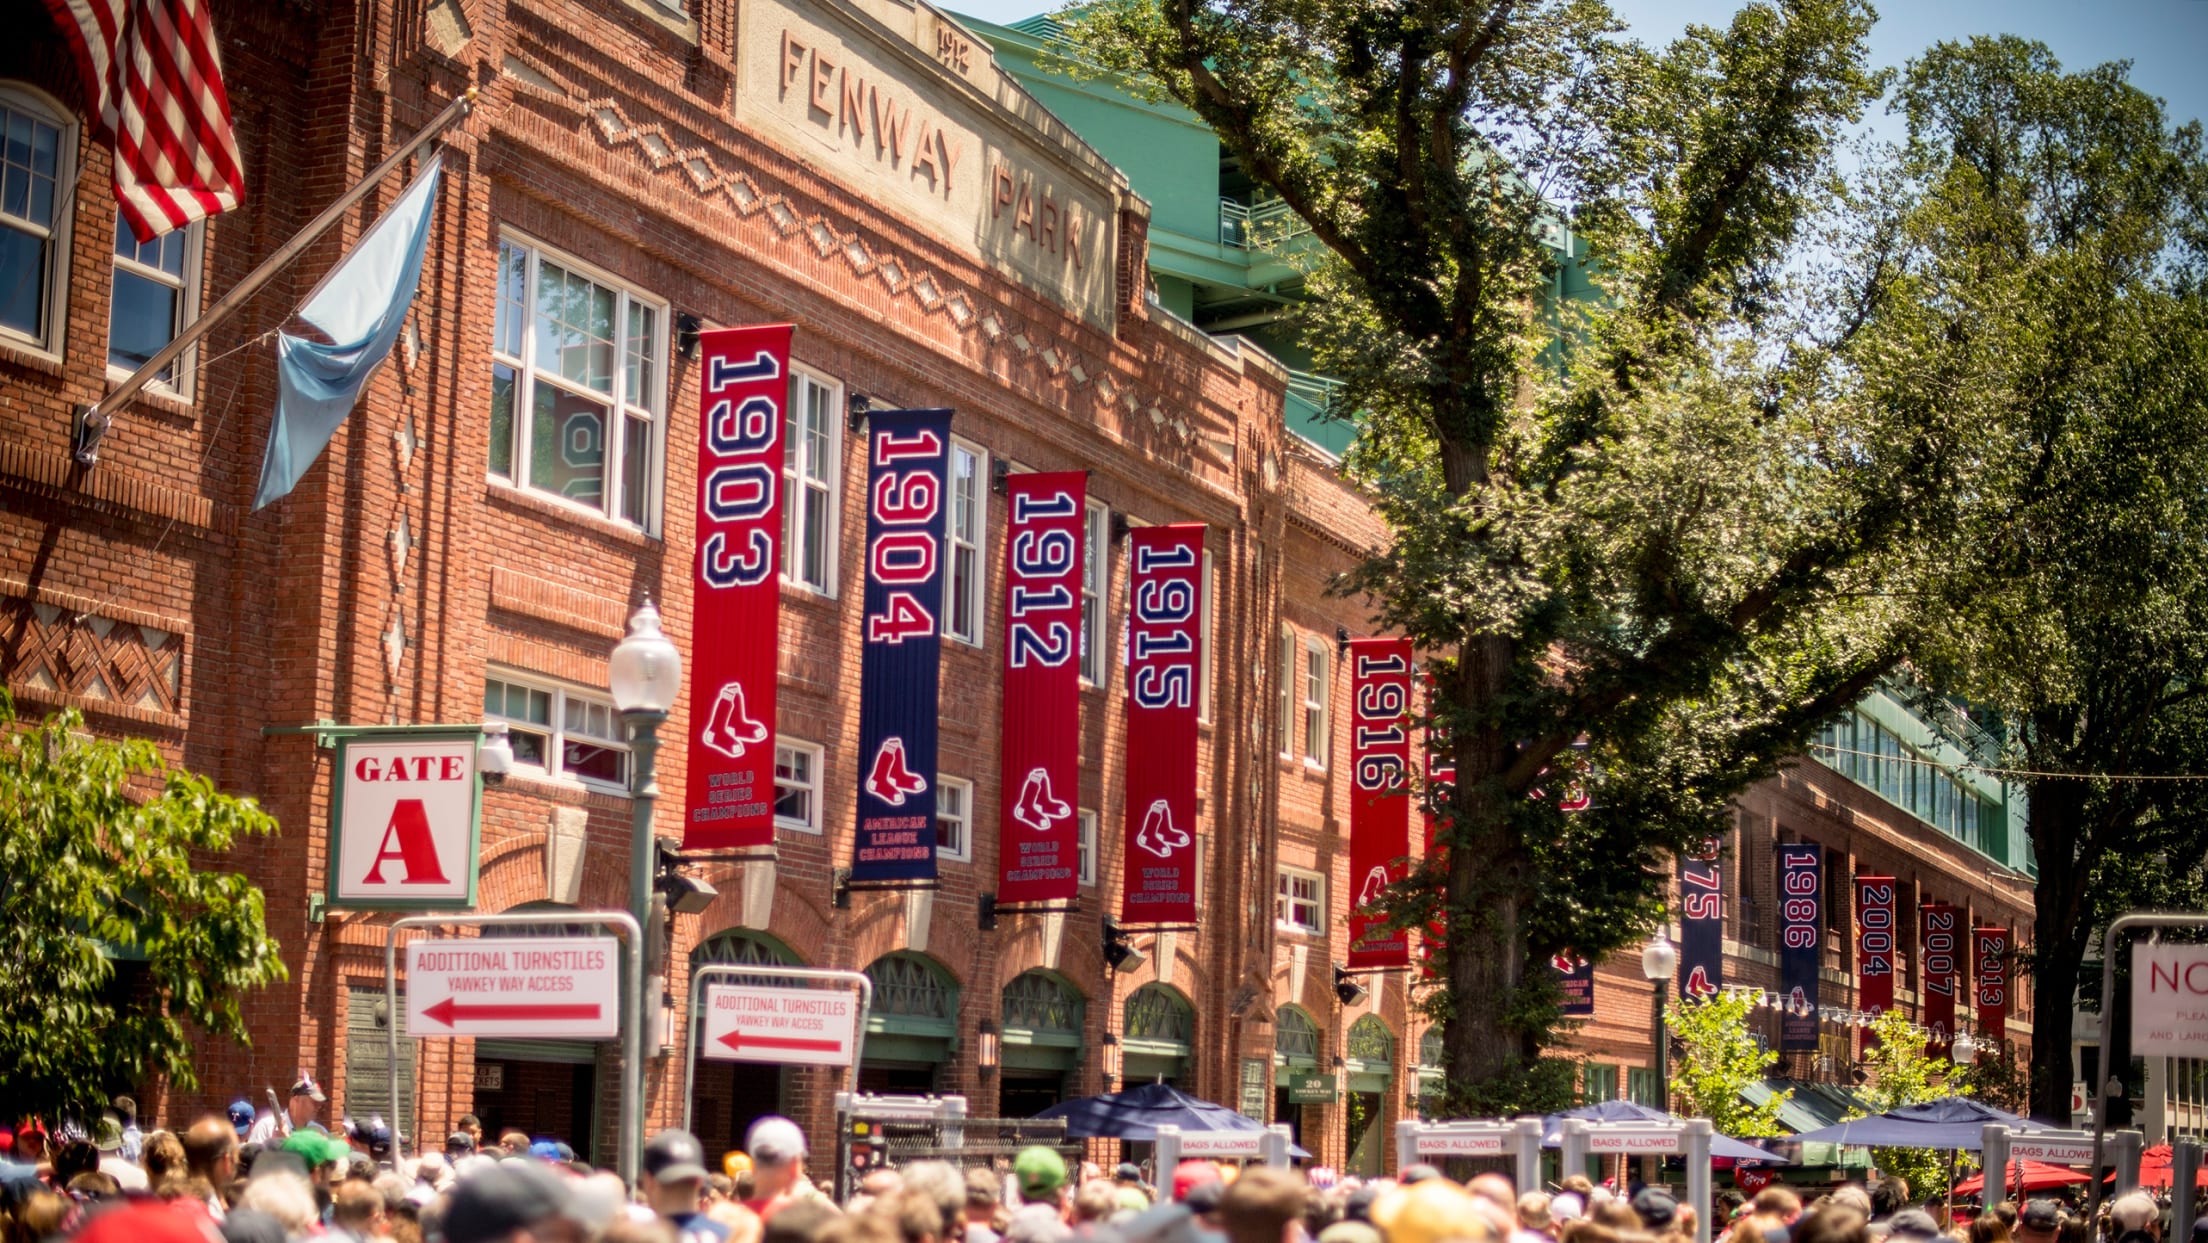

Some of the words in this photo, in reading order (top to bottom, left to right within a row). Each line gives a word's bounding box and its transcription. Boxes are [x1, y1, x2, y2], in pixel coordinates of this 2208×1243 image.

[937, 27, 969, 70] 1912
[782, 29, 961, 190] FENWAY
[993, 163, 1083, 269] PARK
[703, 351, 780, 588] 1903
[870, 430, 941, 643] 1904
[1011, 492, 1076, 668] 1912
[1135, 544, 1195, 708] 1915
[1357, 654, 1406, 790] 1916
[355, 755, 465, 782] GATE
[708, 770, 754, 787] WORLD
[708, 787, 752, 804] SERIES
[693, 802, 768, 822] CHAMPIONS
[863, 816, 927, 830] AMERICAN
[362, 799, 451, 884] A
[871, 831, 918, 845] LEAGUE
[859, 846, 930, 861] CHAMPIONS
[1684, 834, 1720, 919] 975
[1785, 853, 1816, 948] 1986
[1863, 885, 1891, 976] 2004
[417, 951, 508, 972] ADDITIONAL
[512, 950, 605, 970] TURNSTILES
[1927, 913, 1953, 996] 2007
[1981, 937, 2004, 1006] 2013
[447, 976, 496, 992] YAWKEY
[499, 976, 525, 992] WAY
[527, 975, 574, 992] ACCESS
[715, 995, 779, 1012] ADDITIONAL
[782, 998, 846, 1016] TURNSTILES
[736, 1014, 769, 1027] YAWKEY
[771, 1016, 789, 1028] WAY
[792, 1017, 824, 1031] ACCESS
[2150, 1031, 2174, 1041] AND
[1305, 1080, 1322, 1088] 20
[1183, 1141, 1209, 1149] BAGS
[1212, 1141, 1258, 1149] ALLOWED
[1418, 1140, 1447, 1149] BAGS
[1451, 1139, 1500, 1149] ALLOWED
[1592, 1138, 1622, 1147] BAGS
[1626, 1137, 1677, 1147] ALLOWED
[2011, 1146, 2043, 1157] BAGS
[2047, 1148, 2093, 1159] ALLOWE
